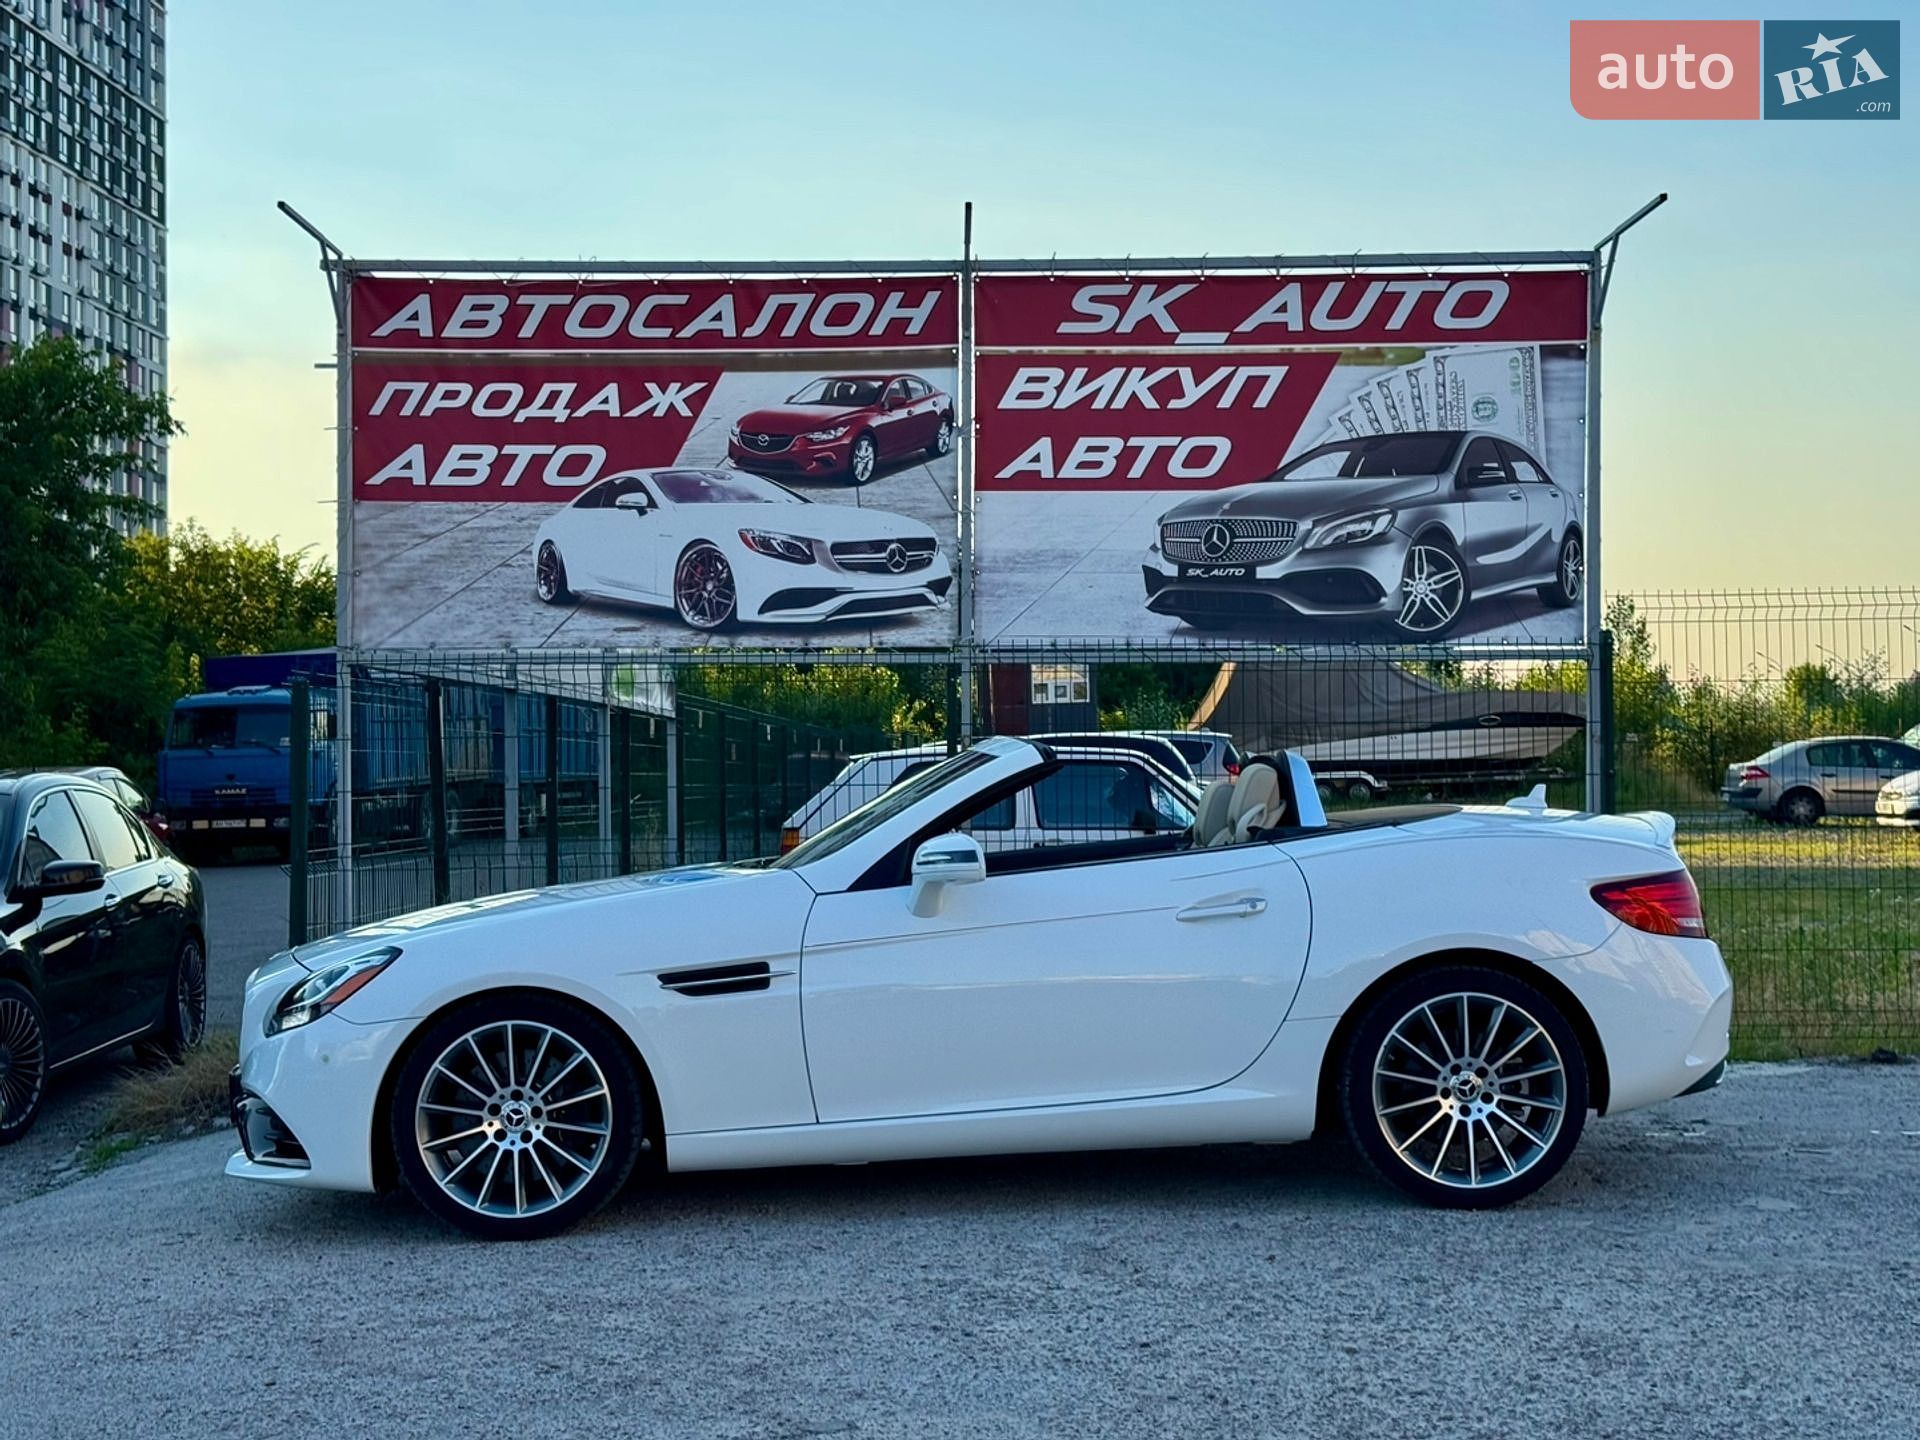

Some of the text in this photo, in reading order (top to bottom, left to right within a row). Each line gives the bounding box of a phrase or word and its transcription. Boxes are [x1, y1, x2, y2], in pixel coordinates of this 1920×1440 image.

[370, 290, 943, 338] АВТОСАЛОН
[1056, 279, 1510, 343] SK_AUTO
[368, 381, 709, 424] ПРОДАЖ
[997, 365, 1290, 410] ВИКУП
[365, 444, 607, 487] АВТО
[995, 436, 1232, 479] АВТО
[1186, 568, 1246, 578] SK_AUTO
